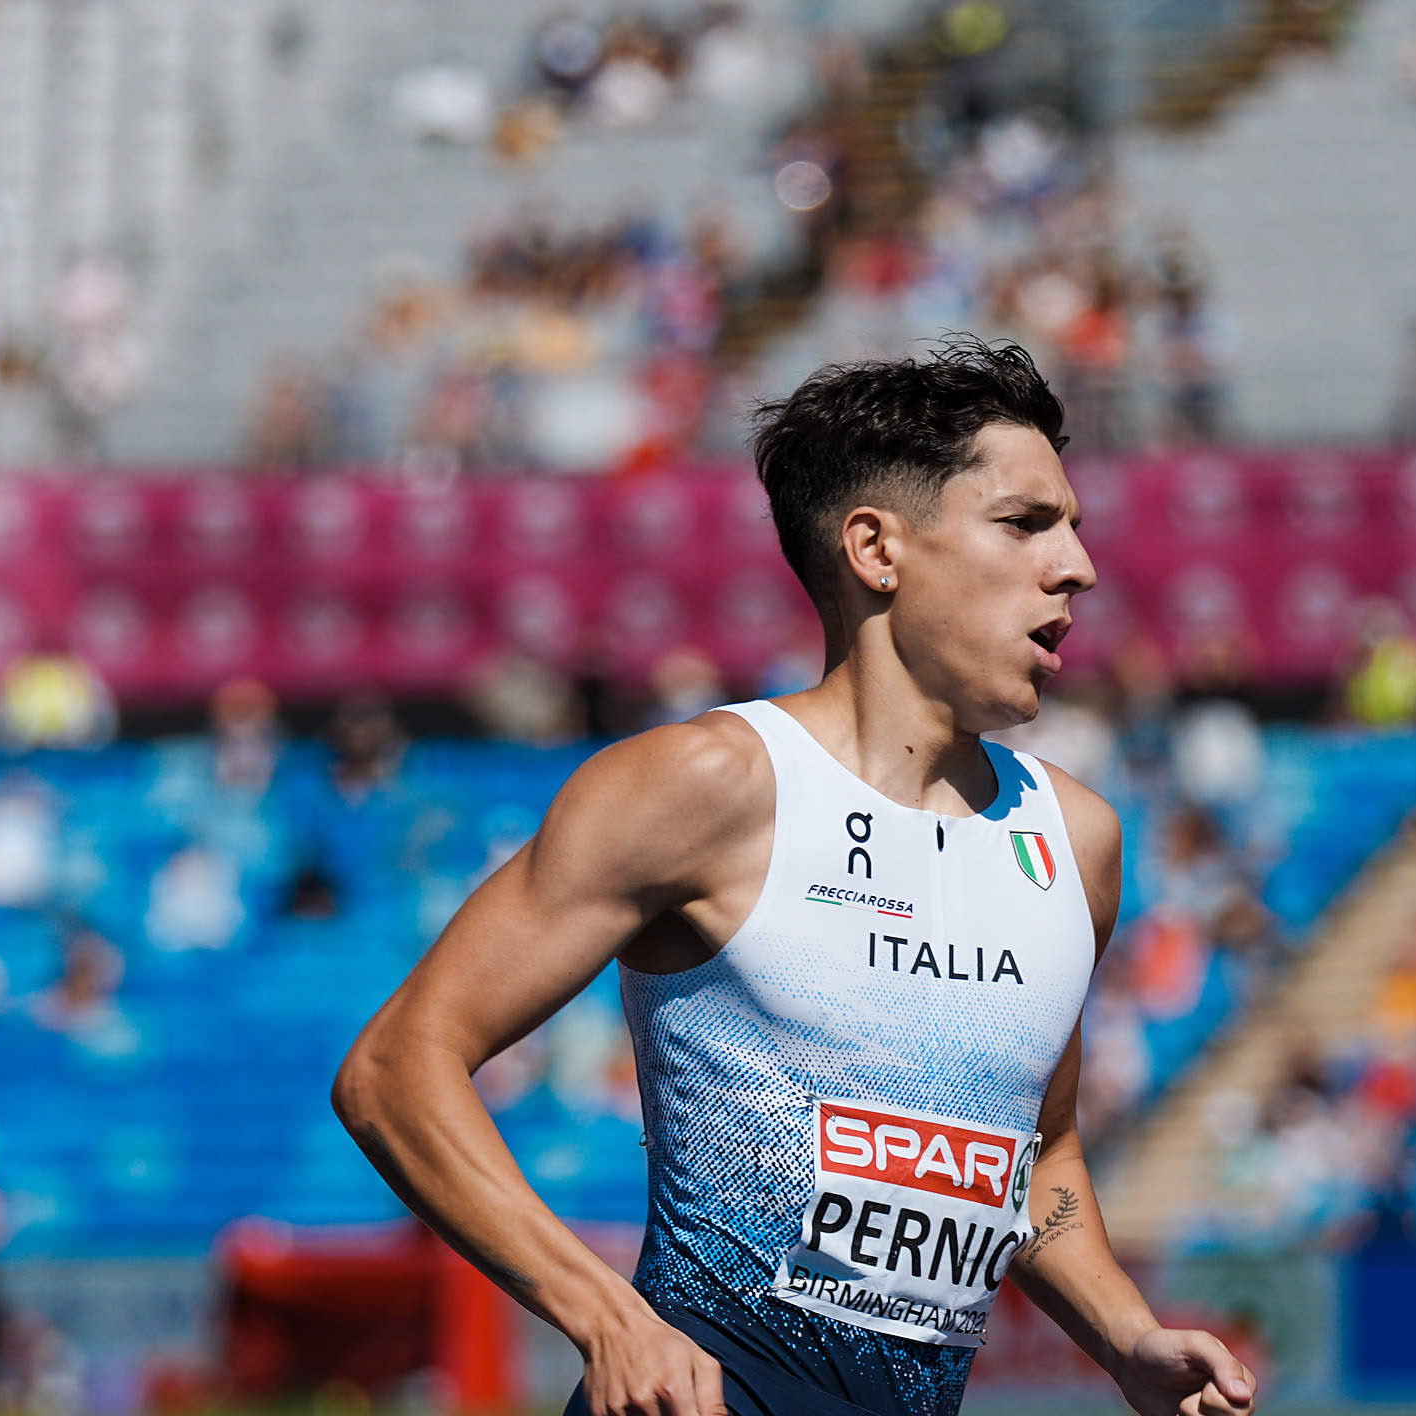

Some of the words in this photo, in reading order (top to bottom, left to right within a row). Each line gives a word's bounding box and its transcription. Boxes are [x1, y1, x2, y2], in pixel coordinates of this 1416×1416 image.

[807, 884, 914, 914] FRECCIAROSSA
[868, 932, 1024, 985] ITALIA
[825, 1115, 1010, 1197] SPAR
